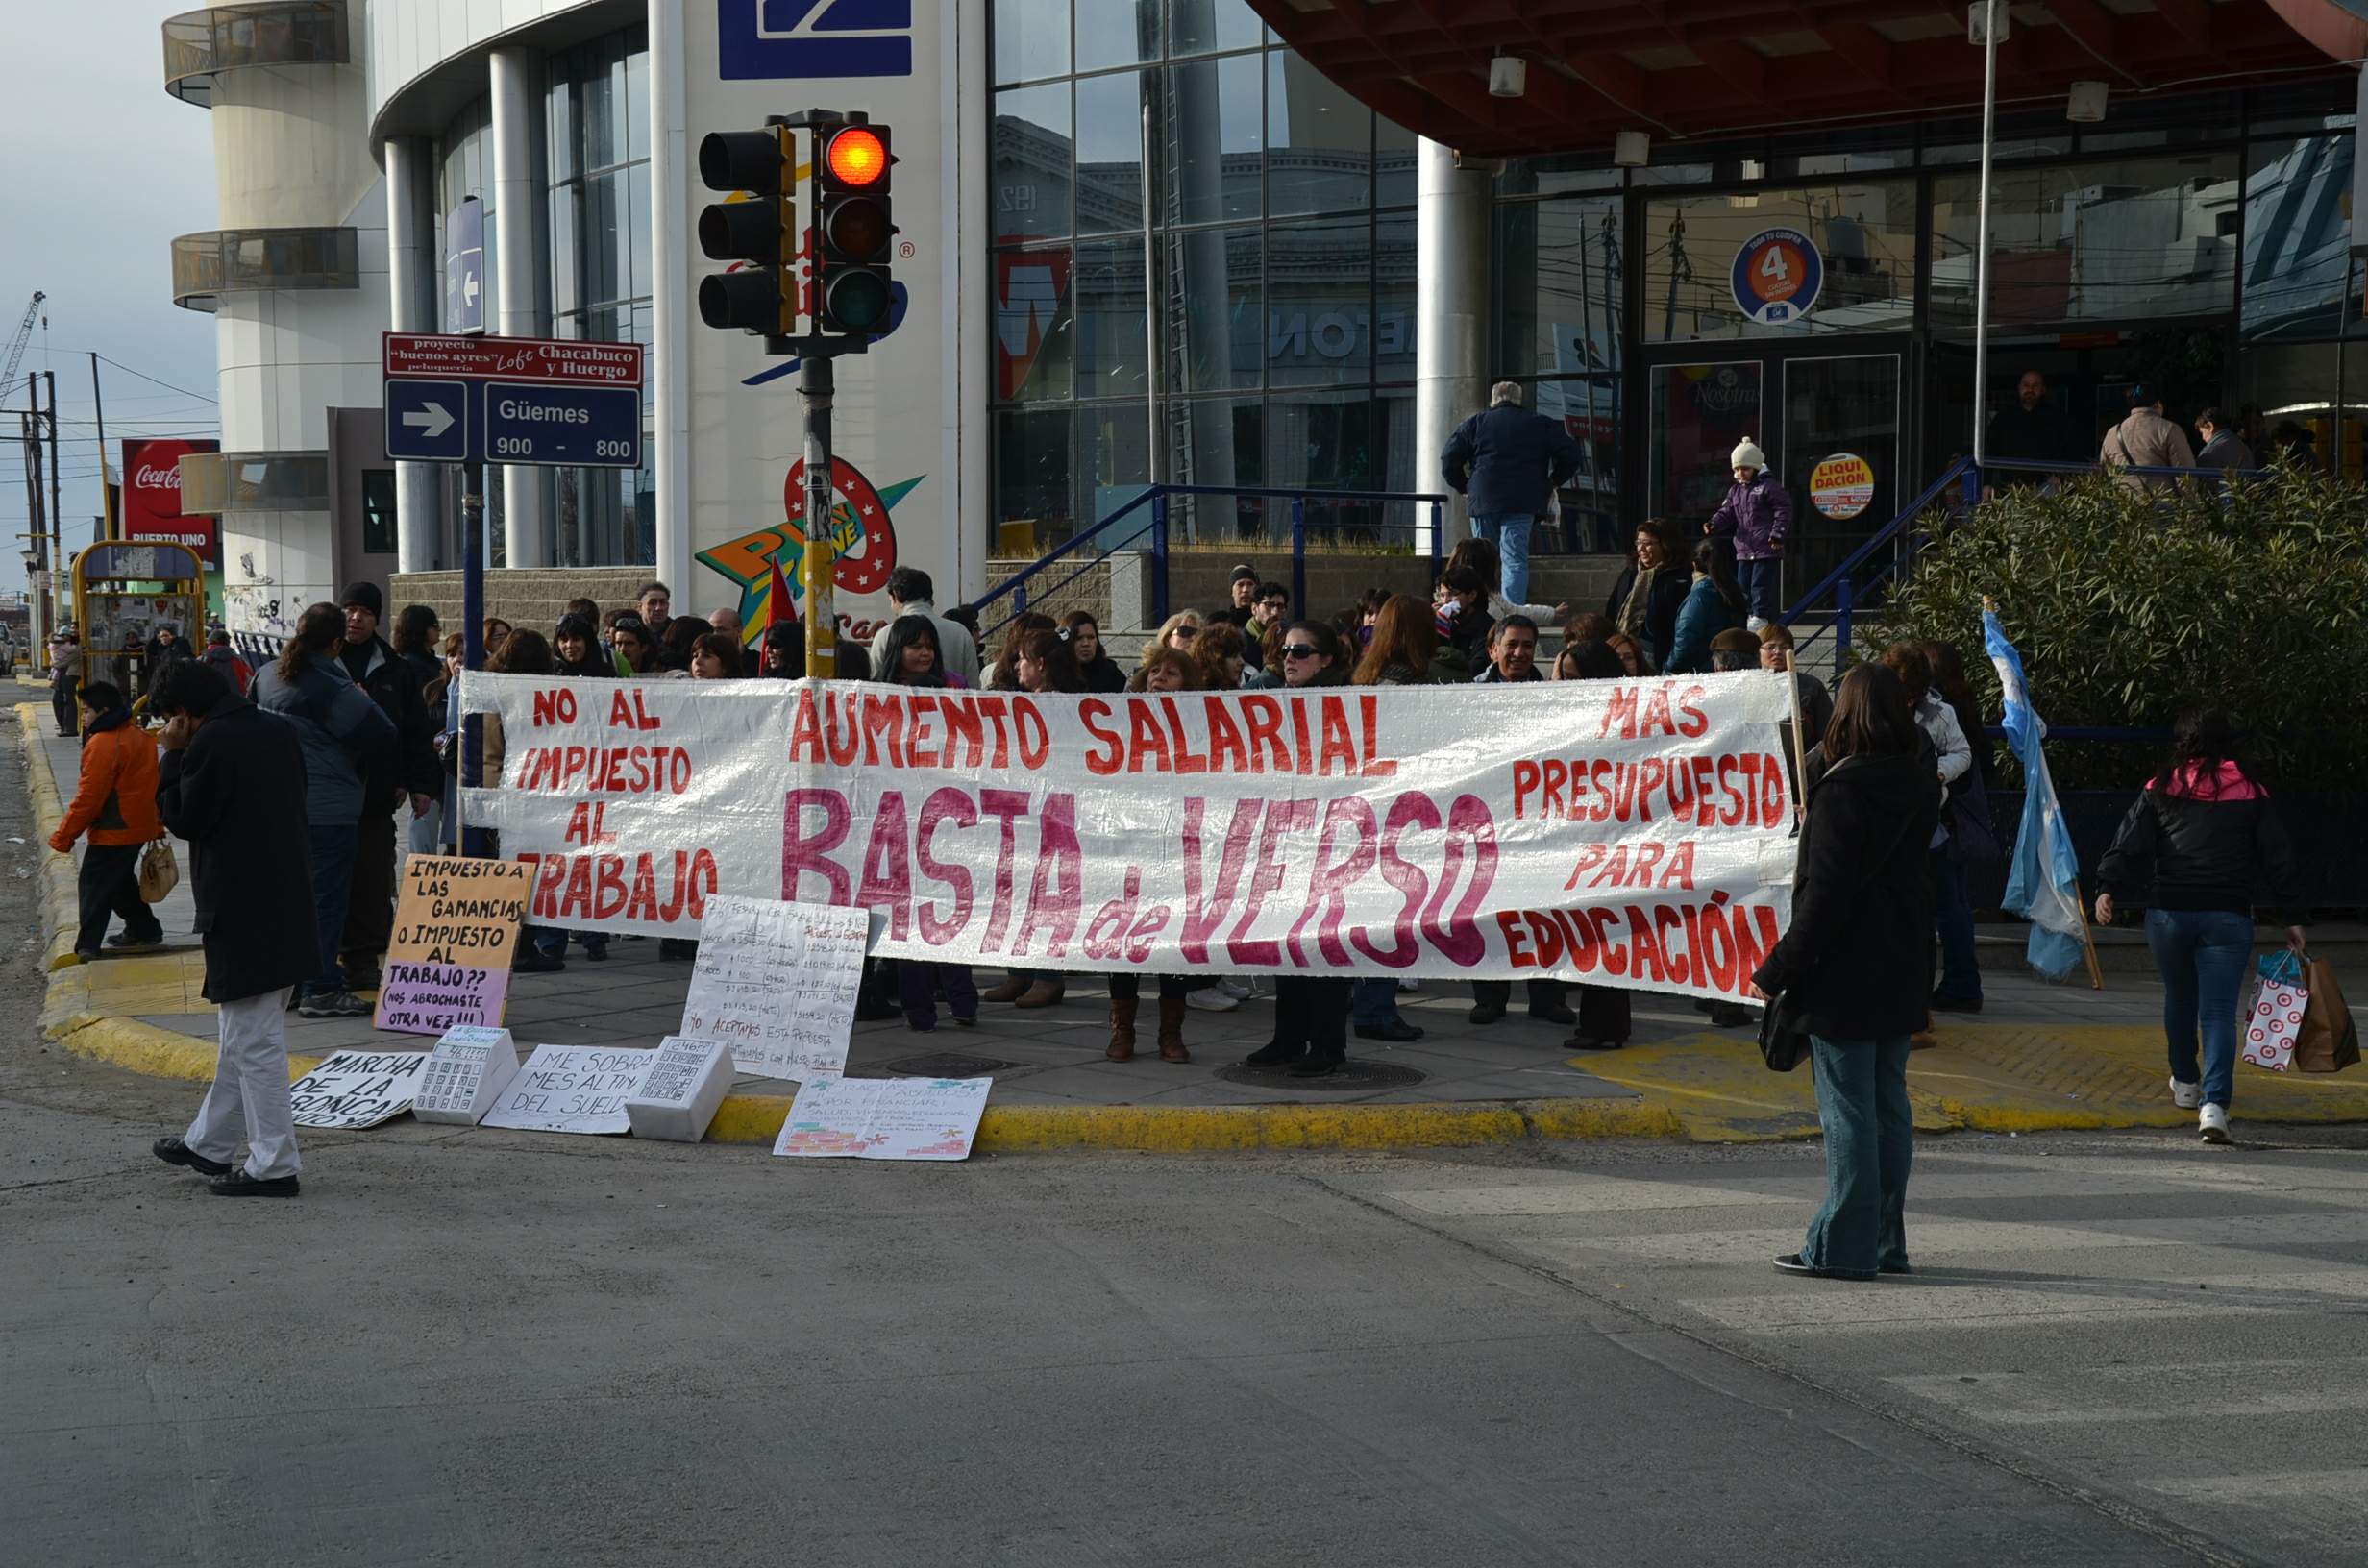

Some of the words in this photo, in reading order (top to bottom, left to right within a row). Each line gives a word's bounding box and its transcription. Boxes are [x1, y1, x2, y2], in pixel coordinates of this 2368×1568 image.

[1761, 245, 1788, 281] 4
[414, 339, 475, 350] proyecto
[538, 345, 634, 363] Chacabuco
[496, 350, 533, 372] Loft
[546, 364, 556, 377] y
[562, 361, 628, 380] Huergo
[499, 399, 590, 424] Güemes
[497, 437, 532, 455] 900
[596, 440, 630, 457] 800
[1818, 461, 1861, 477] LIQUI
[1814, 473, 1865, 489] DACION
[182, 534, 206, 546] UNO
[533, 688, 578, 727] NO
[609, 688, 661, 731] AL
[1595, 680, 1710, 740] MÁS
[789, 688, 1050, 771] AUMENTO
[1078, 694, 1398, 778] SALARIAL
[516, 745, 692, 796] IMPUESTO
[1513, 752, 1785, 830] PRESUPUESTO
[563, 800, 619, 847] AL
[410, 859, 506, 878] IMPUESTO
[509, 865, 524, 879] A
[781, 786, 1082, 958] BASTA
[1082, 866, 1171, 965] de
[1179, 790, 1499, 968] VERSO
[1563, 841, 1696, 892] PARA
[416, 880, 449, 898] LAS
[432, 898, 524, 923] GANANCIAS
[398, 926, 408, 945] O
[411, 924, 505, 948] IMPUESTO
[1496, 889, 1780, 997] EDUCACIÓN
[426, 947, 456, 965] AL
[410, 992, 483, 1008] ABROCHASTE
[389, 1012, 421, 1027] OTRA
[313, 1053, 426, 1078] MARCHA
[581, 1052, 654, 1073] SOBRA
[290, 1077, 342, 1093] DE
[348, 1076, 394, 1097] LA
[524, 1071, 577, 1090] MES
[577, 1074, 604, 1090] AL
[290, 1095, 414, 1116] RONCA!!
[510, 1092, 550, 1113] DEL
[559, 1094, 629, 1115] SUELD
